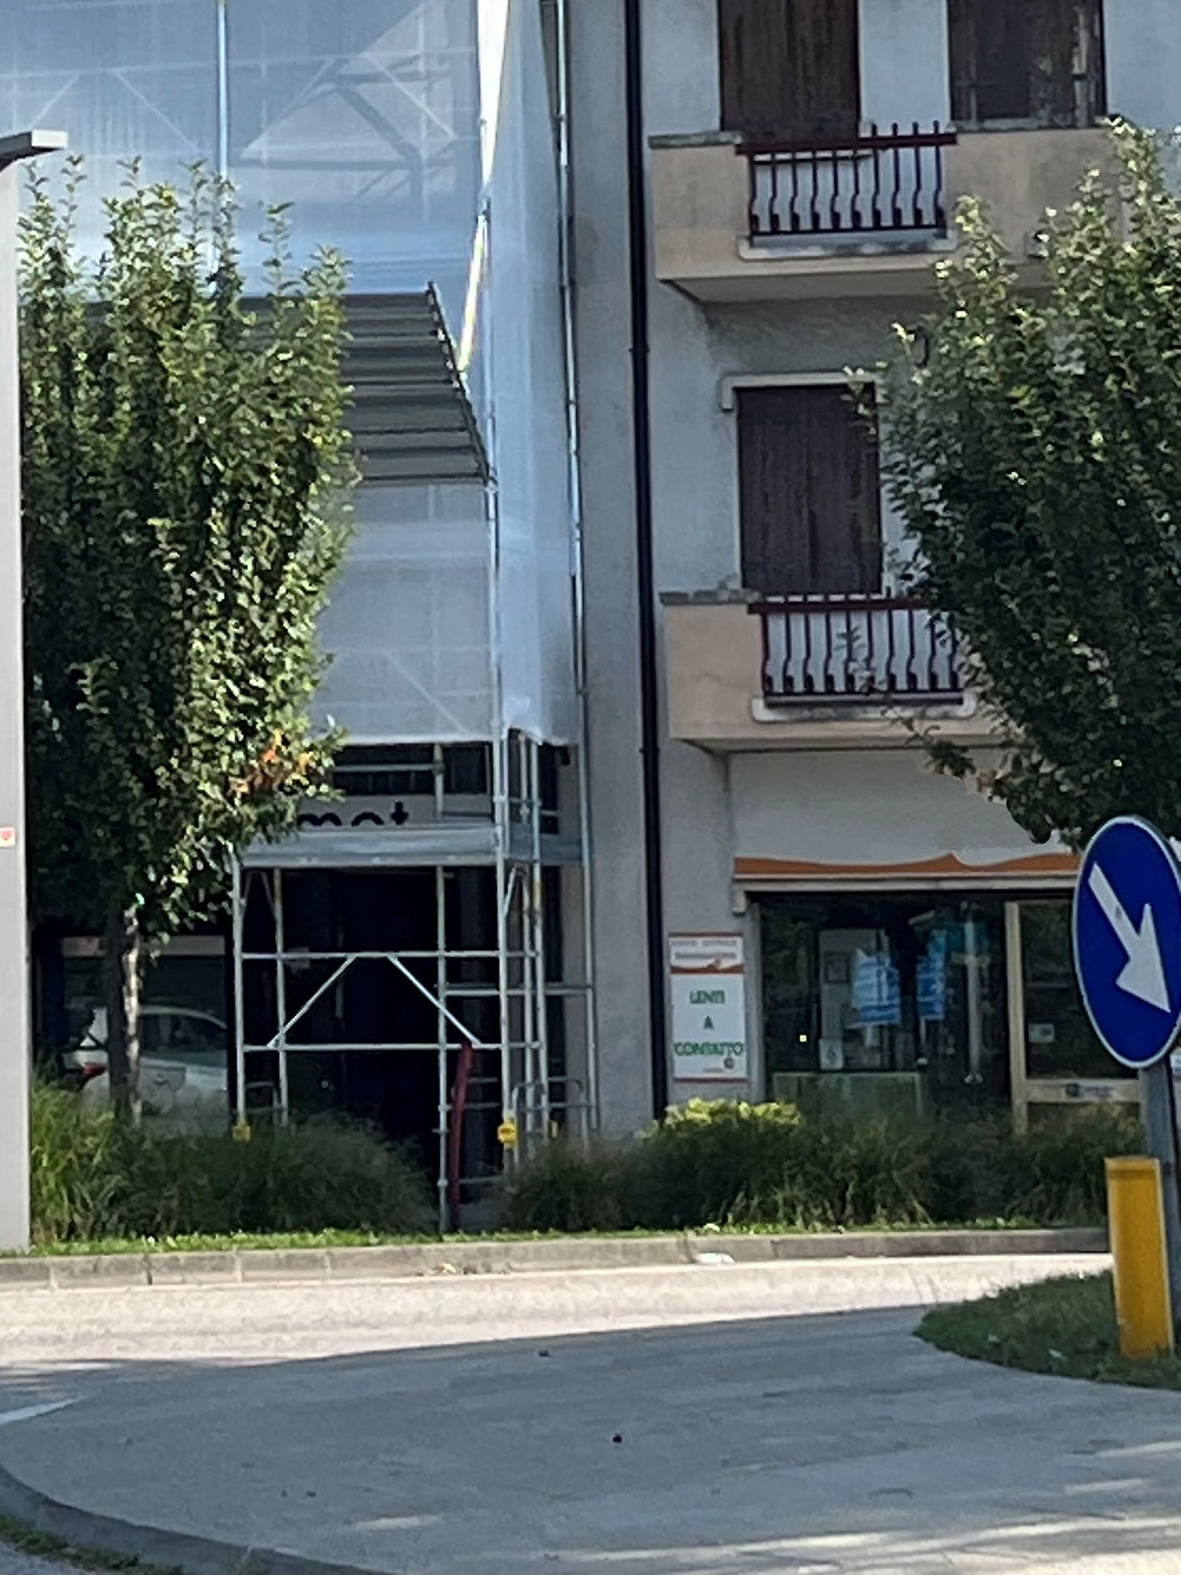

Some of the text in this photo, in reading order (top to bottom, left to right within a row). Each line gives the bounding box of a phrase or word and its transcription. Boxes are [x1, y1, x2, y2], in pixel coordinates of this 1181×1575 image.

[690, 990, 725, 1004] LENTI
[703, 1015, 714, 1030] A
[674, 1041, 744, 1057] CONTATTO
